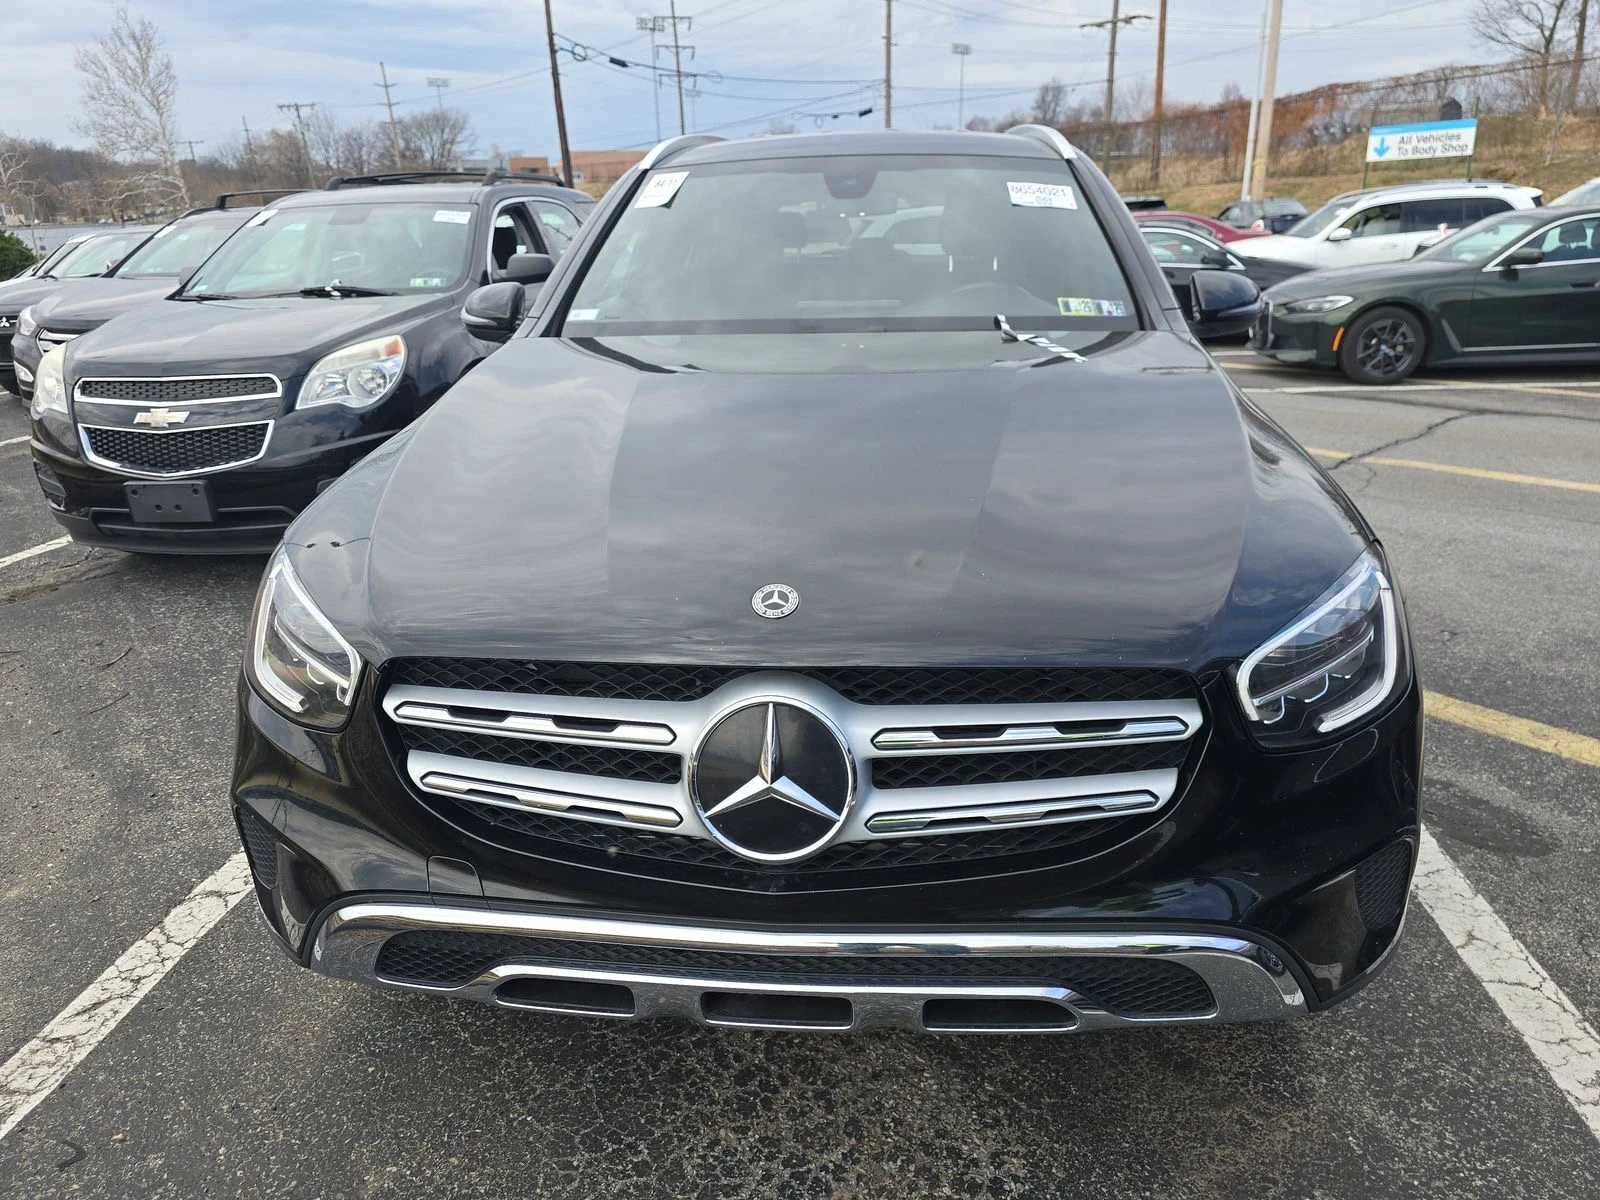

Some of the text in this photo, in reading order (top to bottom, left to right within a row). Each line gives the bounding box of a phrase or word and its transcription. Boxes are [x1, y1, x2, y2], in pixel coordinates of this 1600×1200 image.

[1398, 132, 1461, 145] All Vehicles
[1398, 142, 1468, 157] To Body Shop
